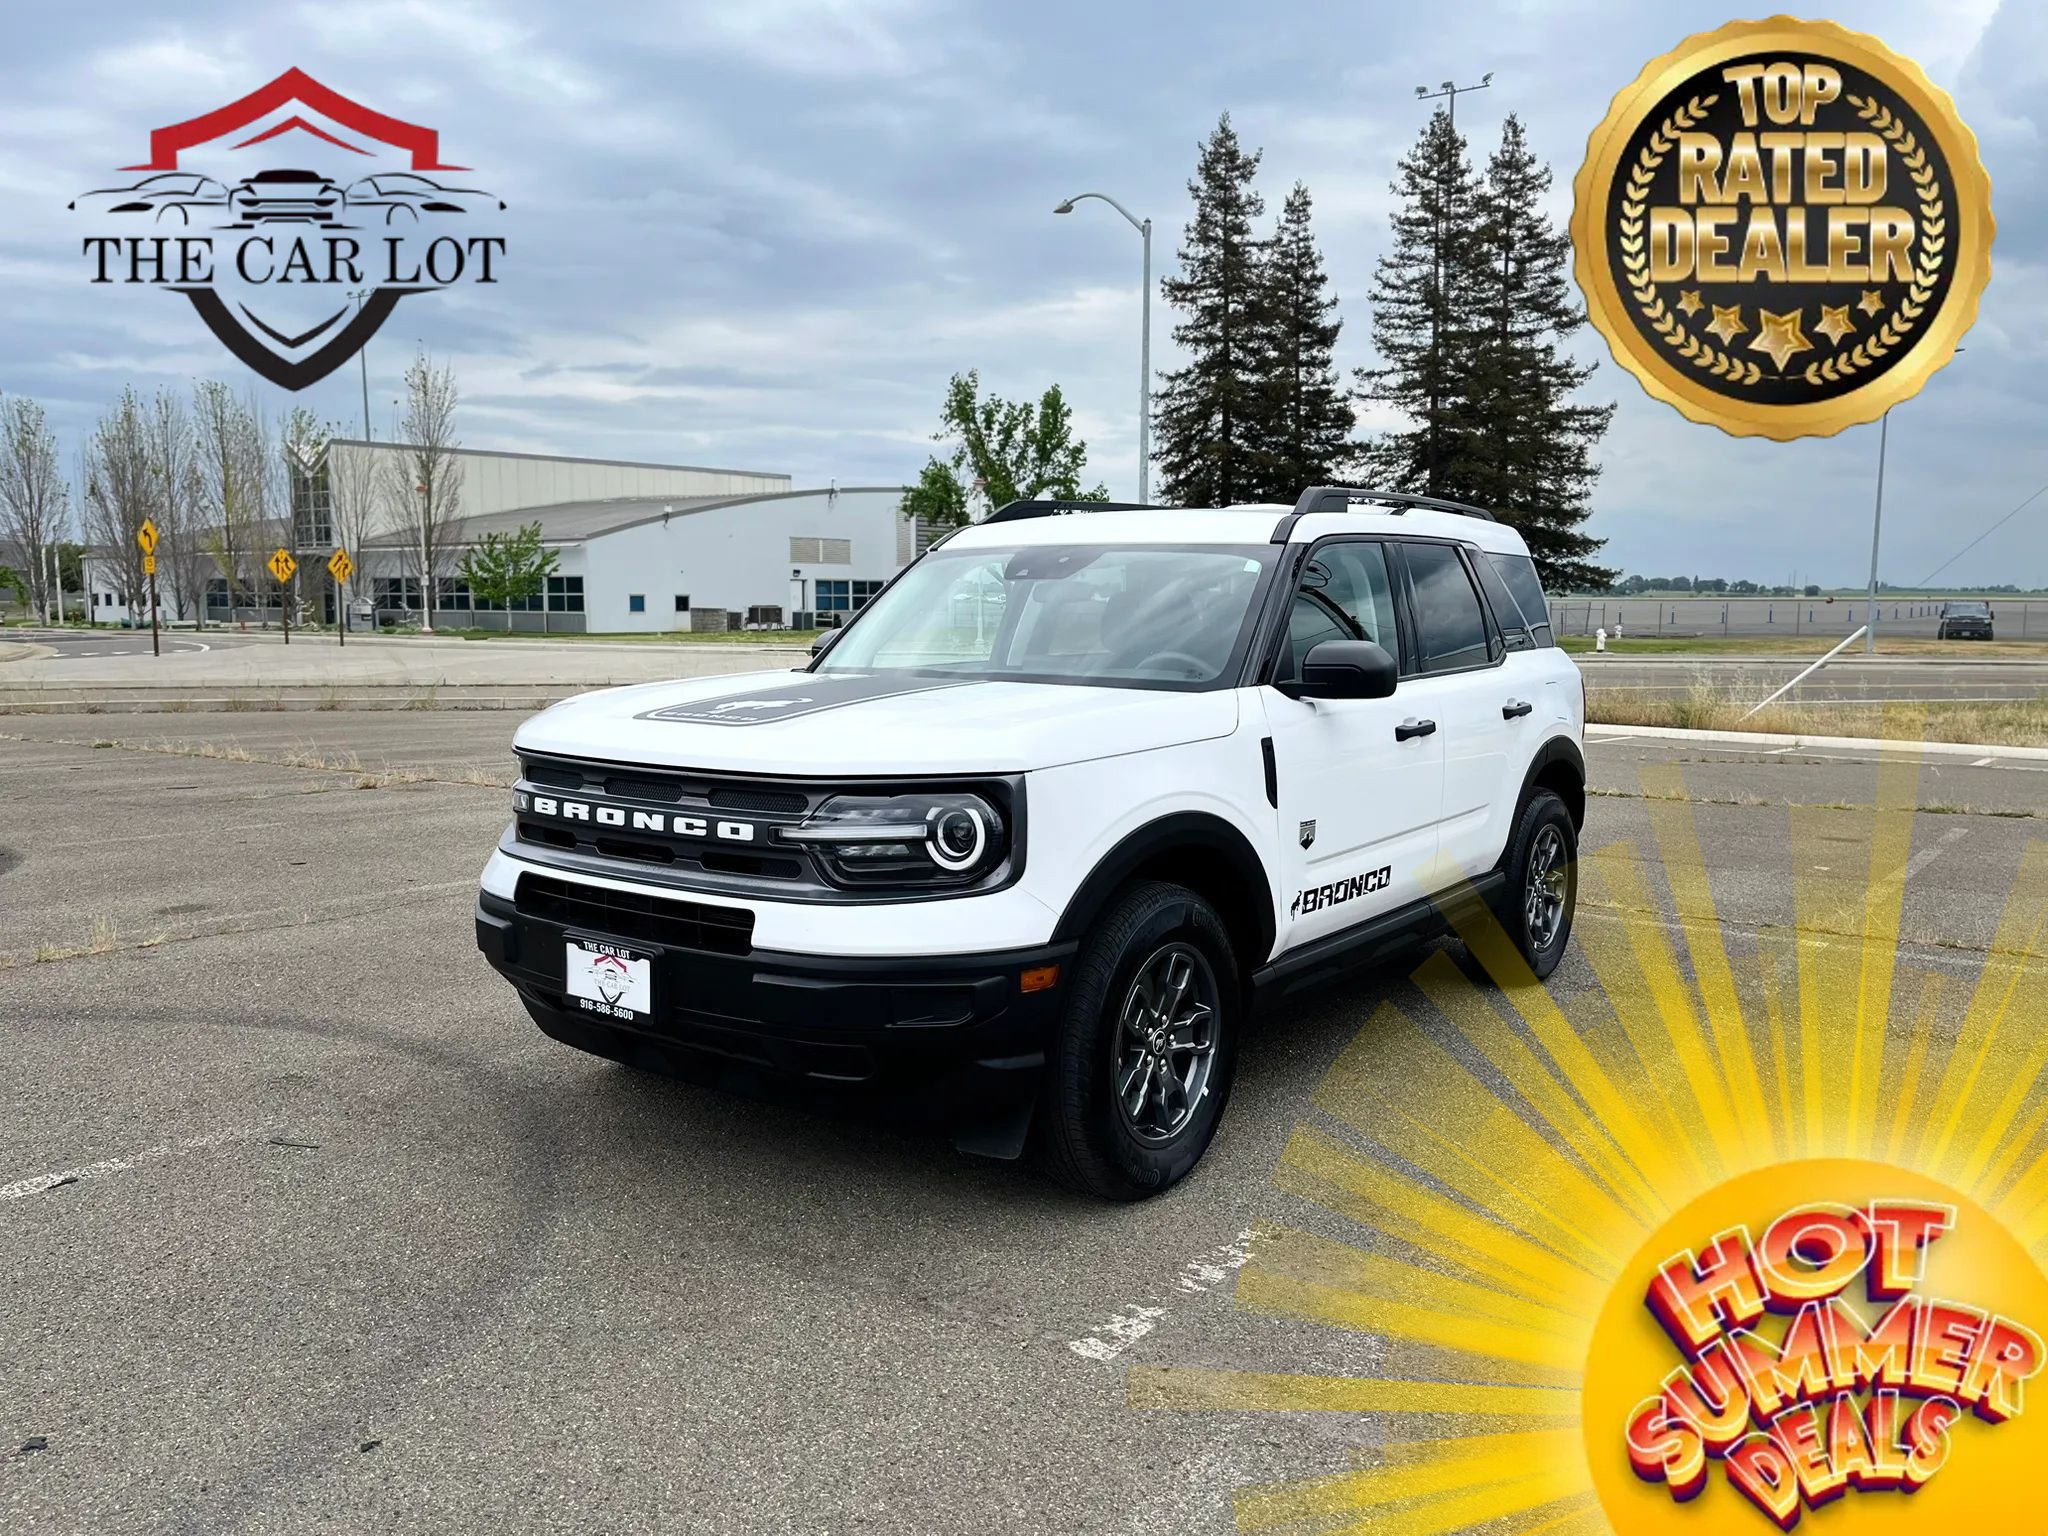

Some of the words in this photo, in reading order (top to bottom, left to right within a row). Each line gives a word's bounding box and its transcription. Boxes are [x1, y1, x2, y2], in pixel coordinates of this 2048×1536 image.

[534, 797, 754, 841] BRONCO
[1302, 865, 1391, 914] BRONCO
[584, 941, 598, 952] THE
[599, 944, 615, 956] CAR
[616, 948, 630, 958] LOT
[580, 998, 633, 1020] 916-586-5600
